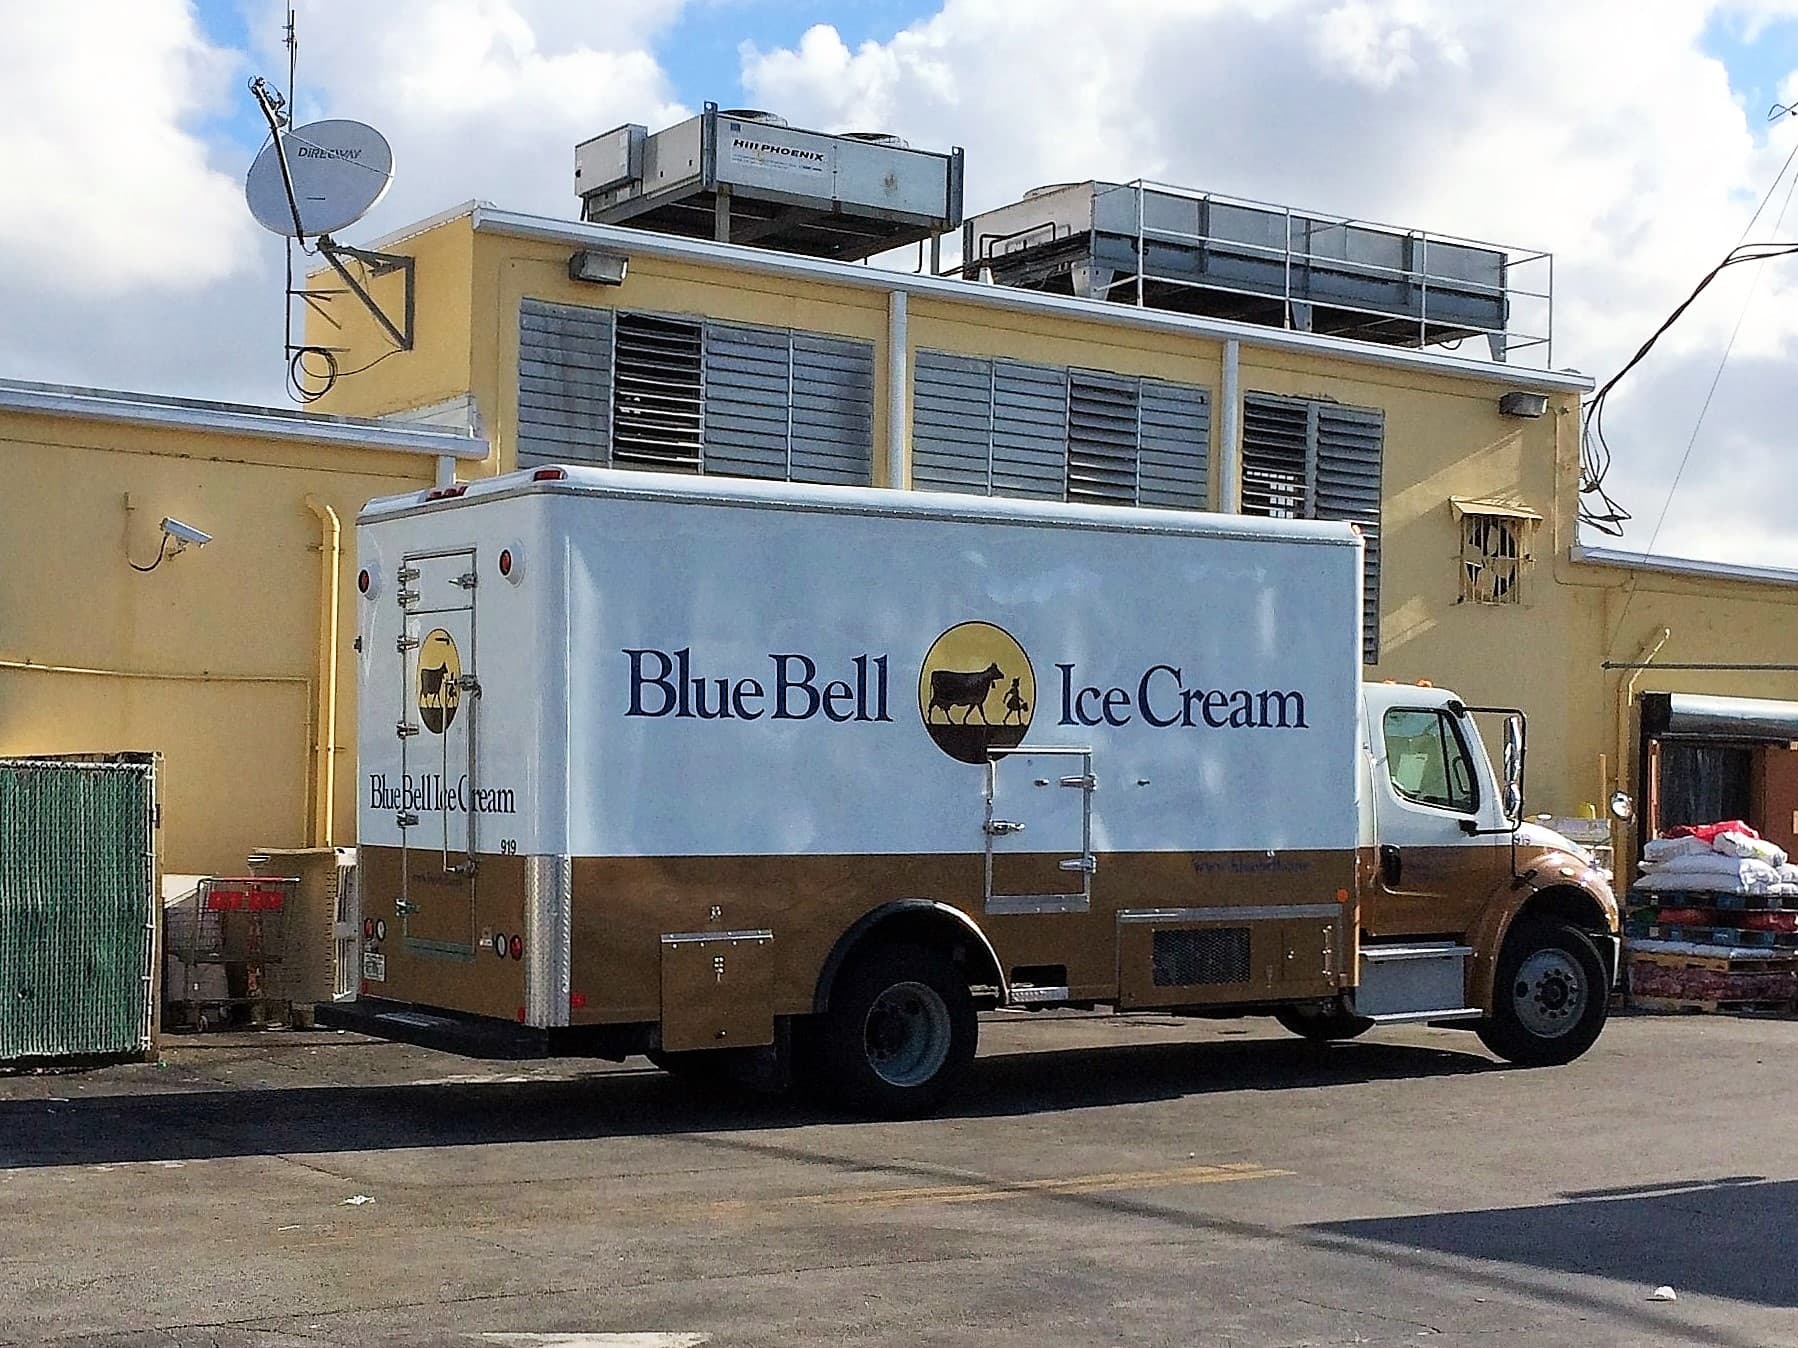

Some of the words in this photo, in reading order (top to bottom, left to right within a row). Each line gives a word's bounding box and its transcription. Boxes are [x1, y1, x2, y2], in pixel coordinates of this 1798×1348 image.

[622, 647, 765, 720] Blue
[769, 653, 893, 722] Bell
[1055, 663, 1131, 727] Ice
[1137, 665, 1309, 728] Cream
[370, 774, 400, 809] Blue
[402, 774, 432, 811] Bell
[501, 839, 516, 854] 919
